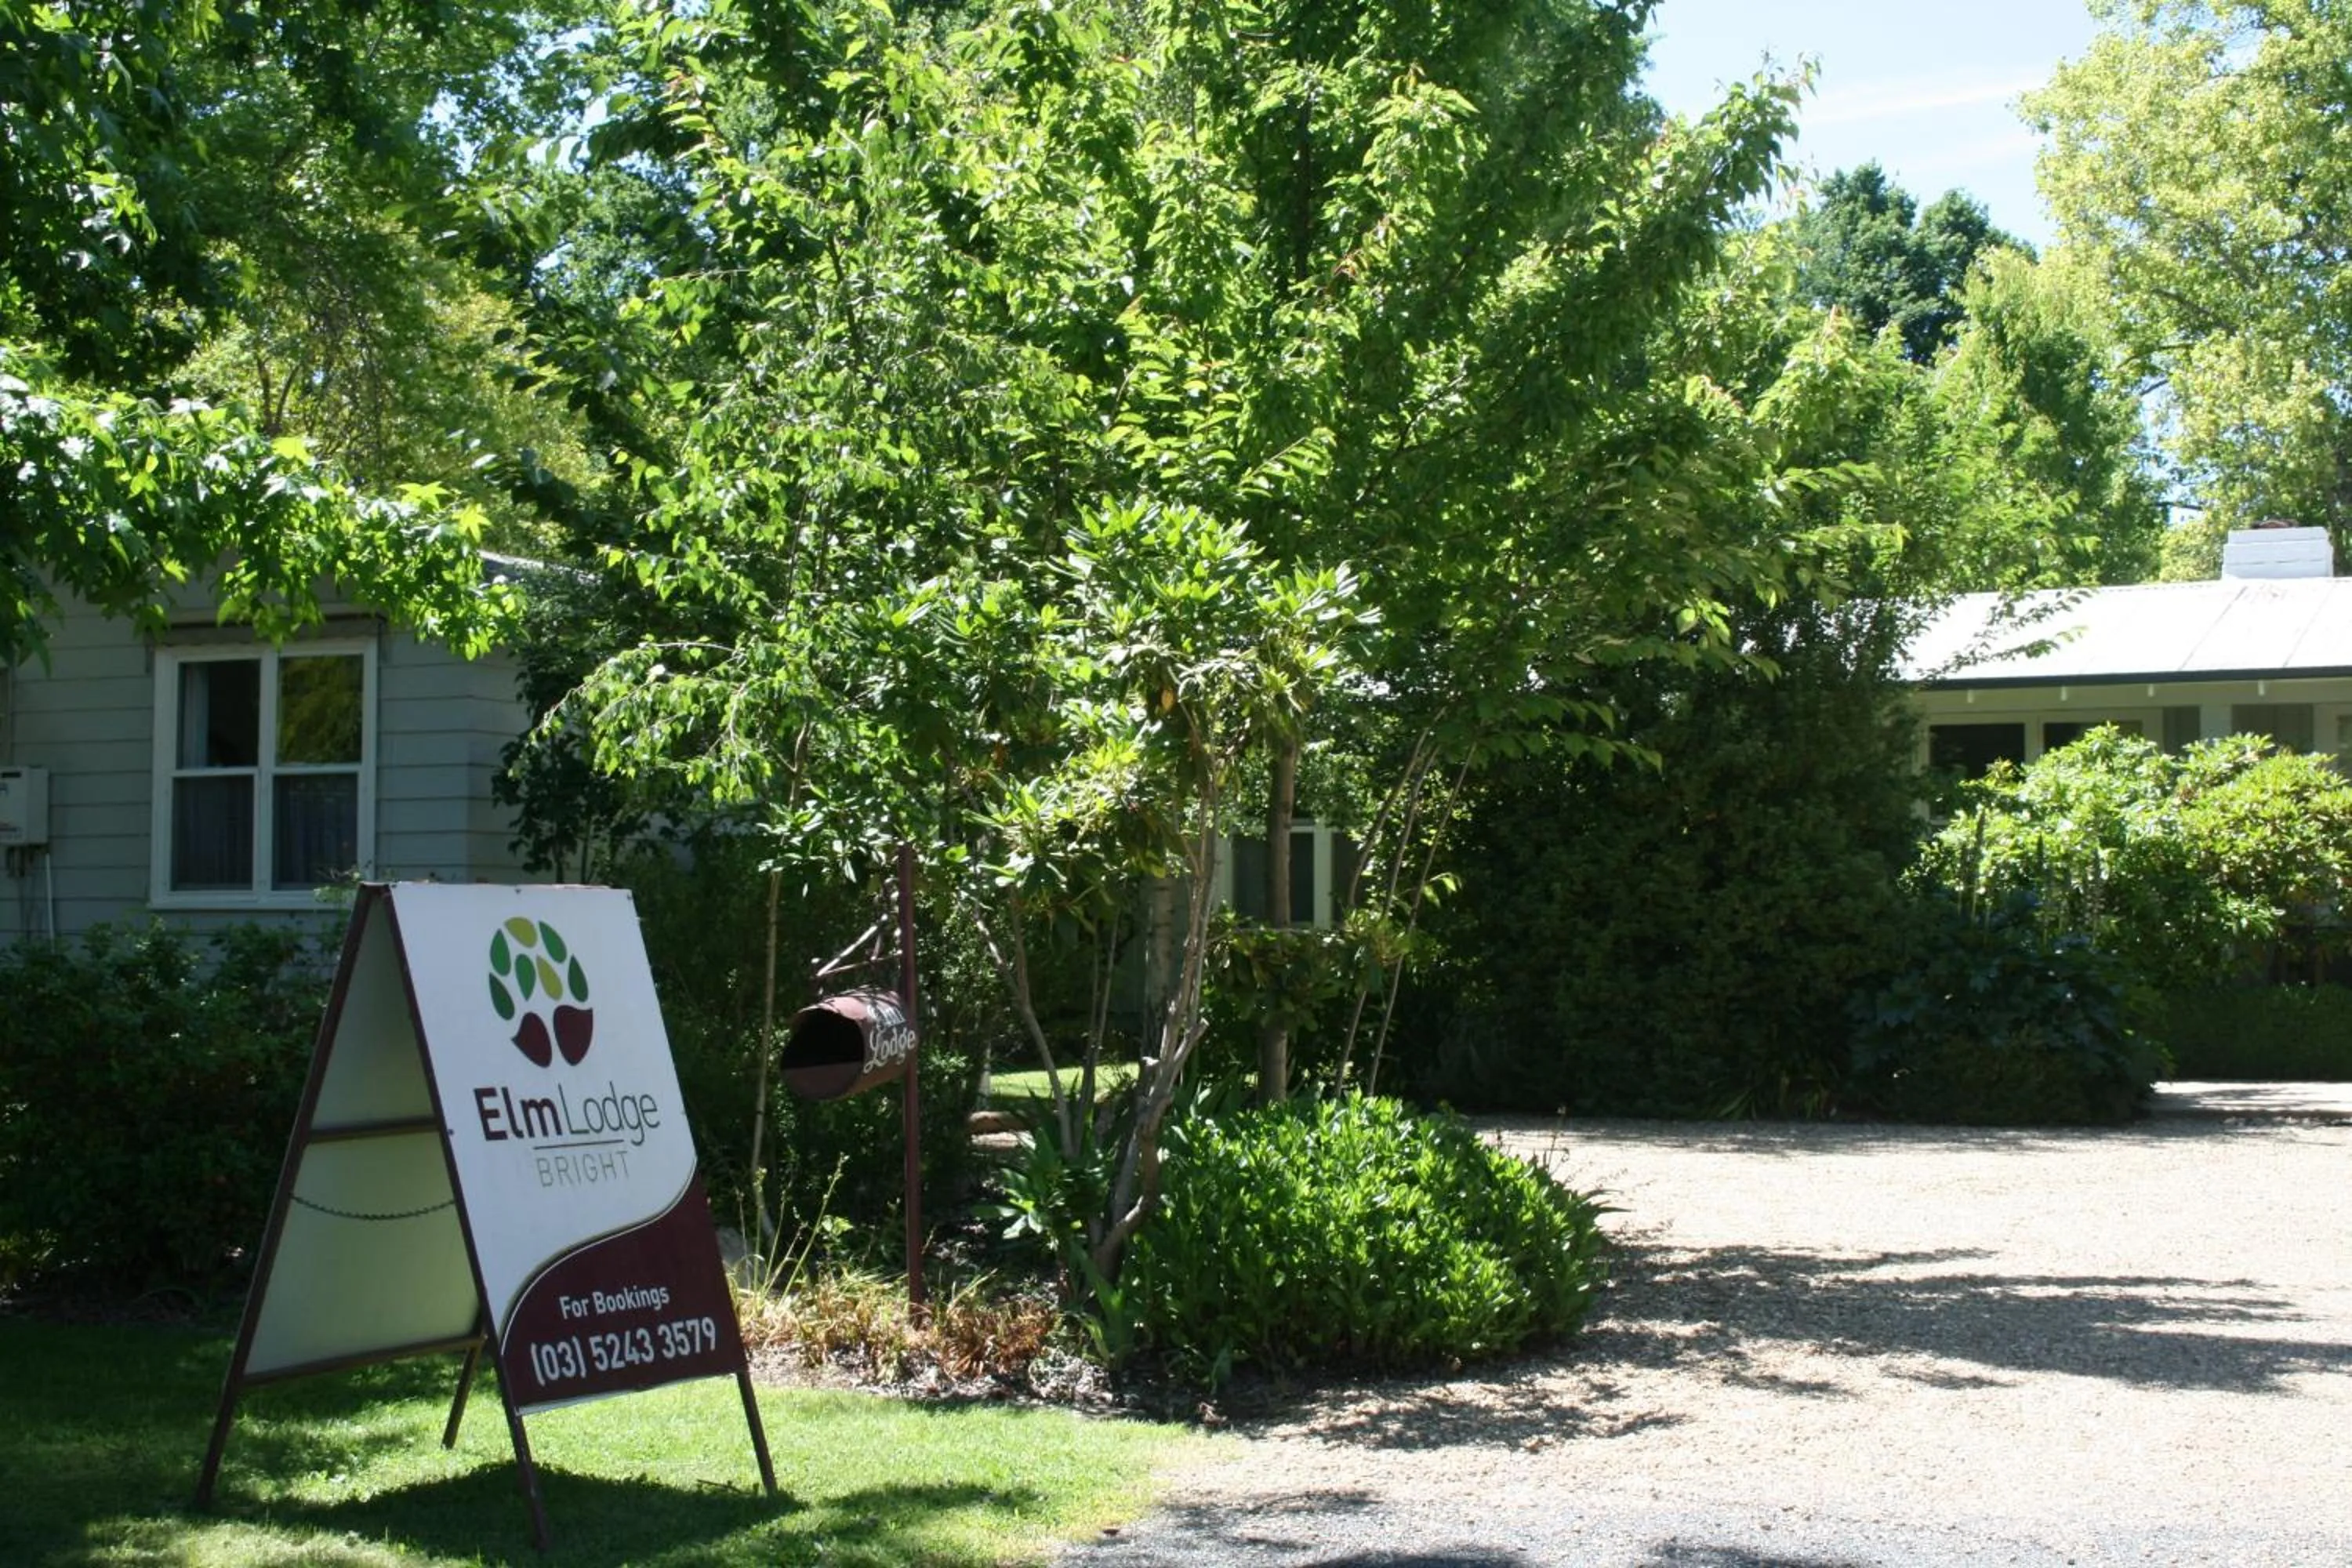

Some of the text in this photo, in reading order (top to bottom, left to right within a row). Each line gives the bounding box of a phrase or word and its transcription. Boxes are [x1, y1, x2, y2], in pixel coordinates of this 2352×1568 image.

[863, 1026, 916, 1074] Lodge
[536, 1151, 630, 1187] BRIGHT
[559, 1284, 670, 1320] For Bookings
[530, 1316, 717, 1387] (03) 5243 3579
